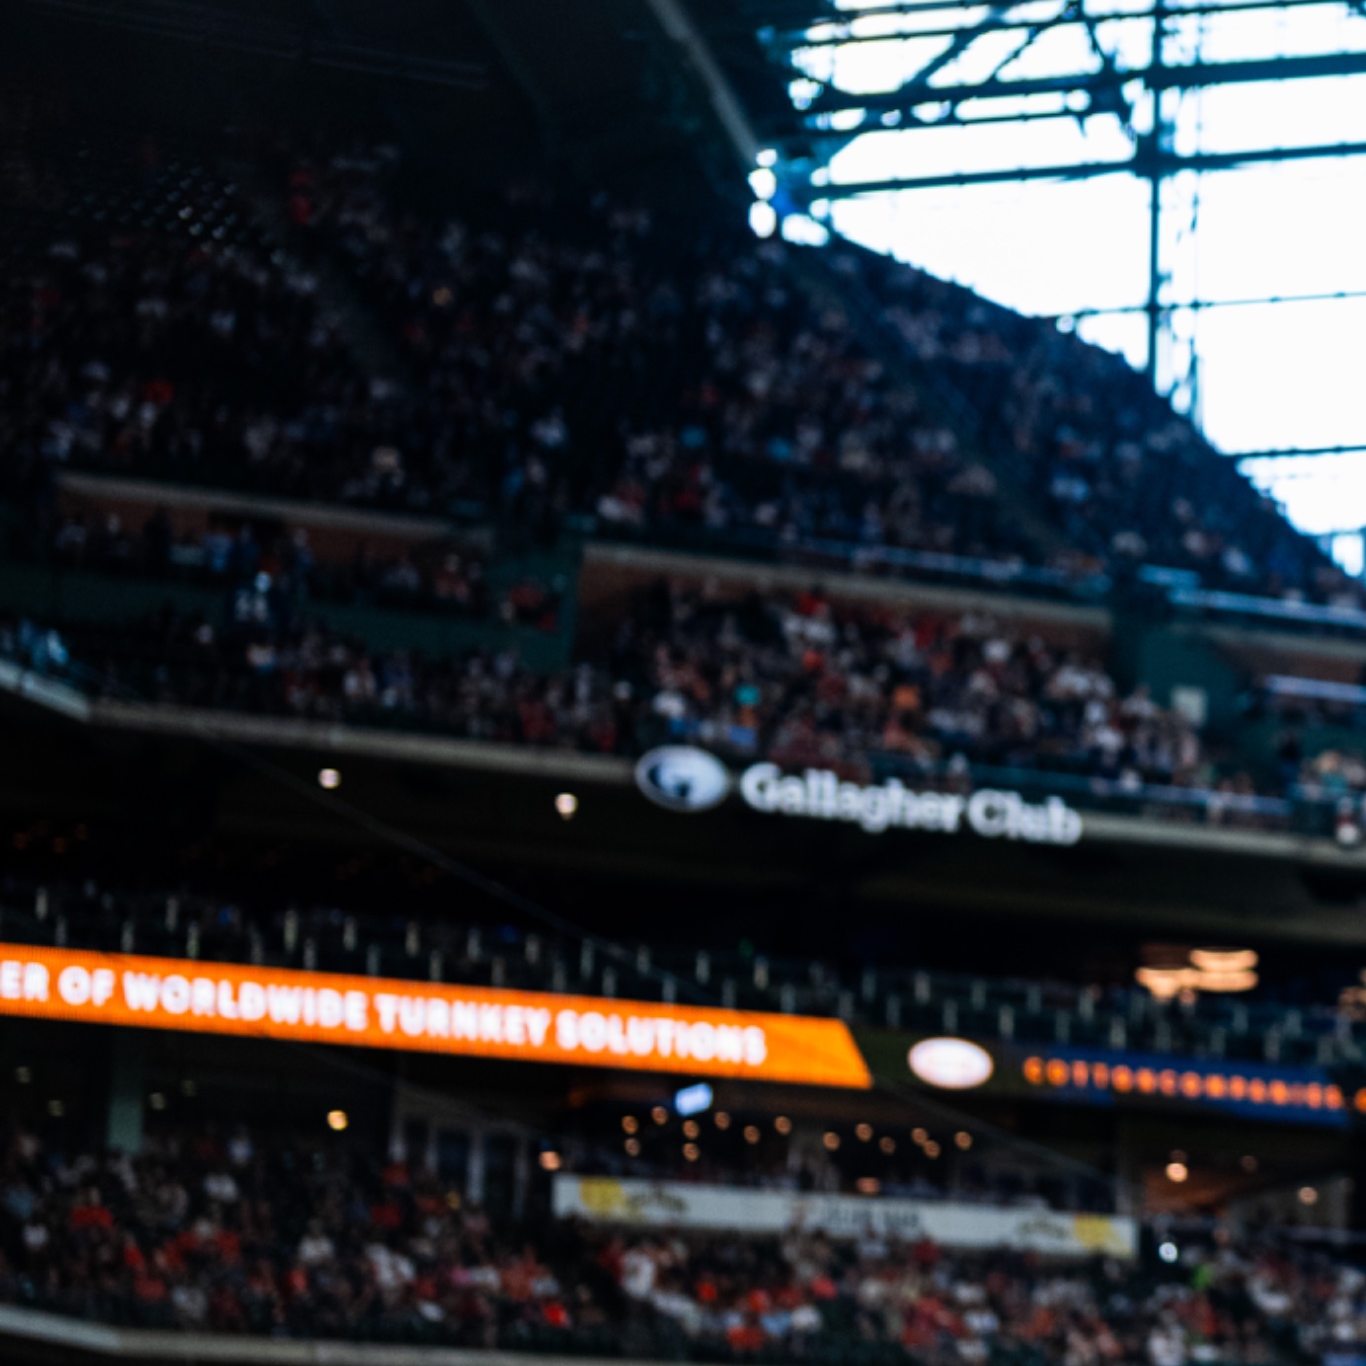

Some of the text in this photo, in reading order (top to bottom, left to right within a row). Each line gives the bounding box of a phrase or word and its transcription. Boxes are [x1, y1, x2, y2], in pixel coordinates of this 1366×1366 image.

[740, 761, 1083, 846] Gallagher Club
[57, 965, 116, 1007] OF
[122, 971, 368, 1032] WORLDWIDE
[373, 992, 552, 1048] TURNKEY
[554, 1009, 768, 1067] SOLUTIONS
